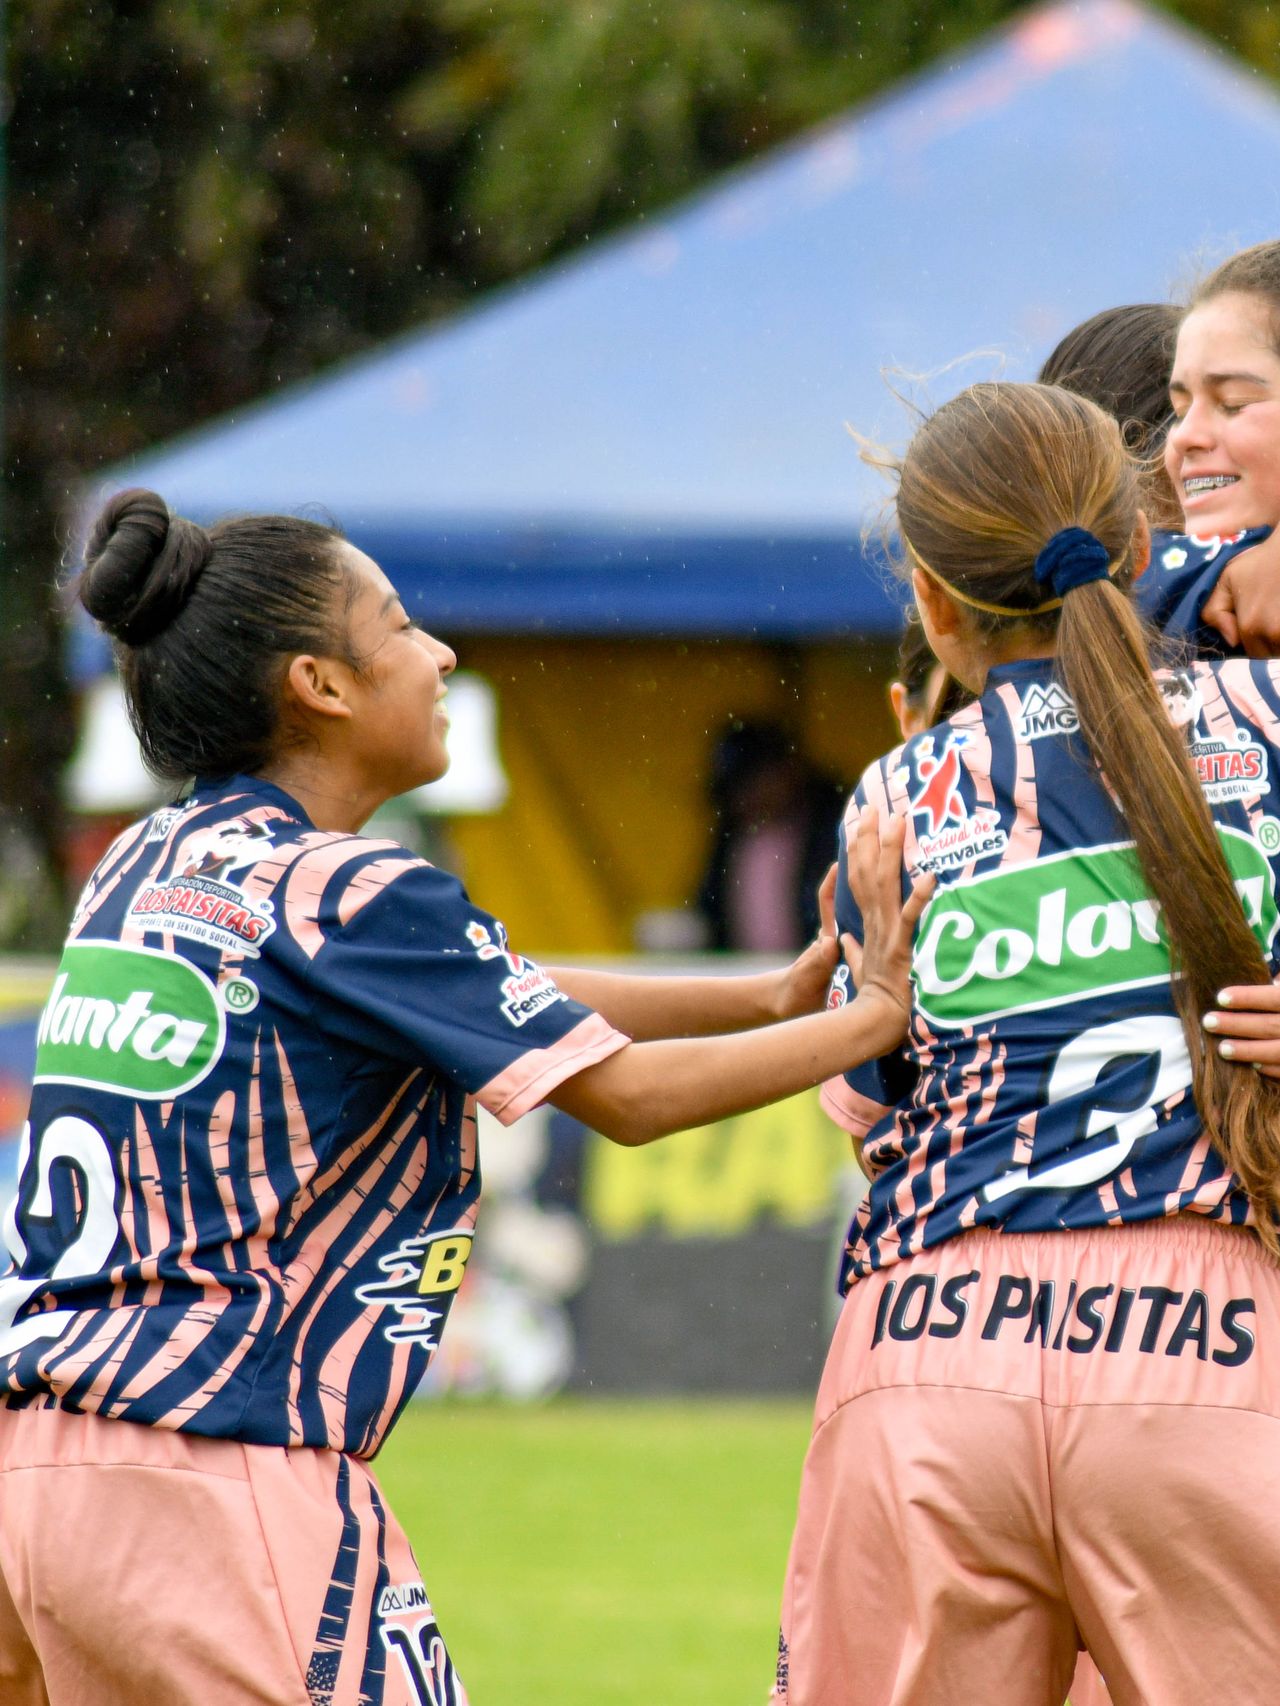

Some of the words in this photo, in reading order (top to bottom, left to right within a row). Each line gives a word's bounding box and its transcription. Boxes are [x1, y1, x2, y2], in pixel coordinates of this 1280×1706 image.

[1021, 709, 1078, 738] JMG
[132, 887, 172, 914] LOS
[167, 887, 267, 941] PAISITAS
[209, 932, 238, 949] SOCIAL
[37, 972, 208, 1068] lanta
